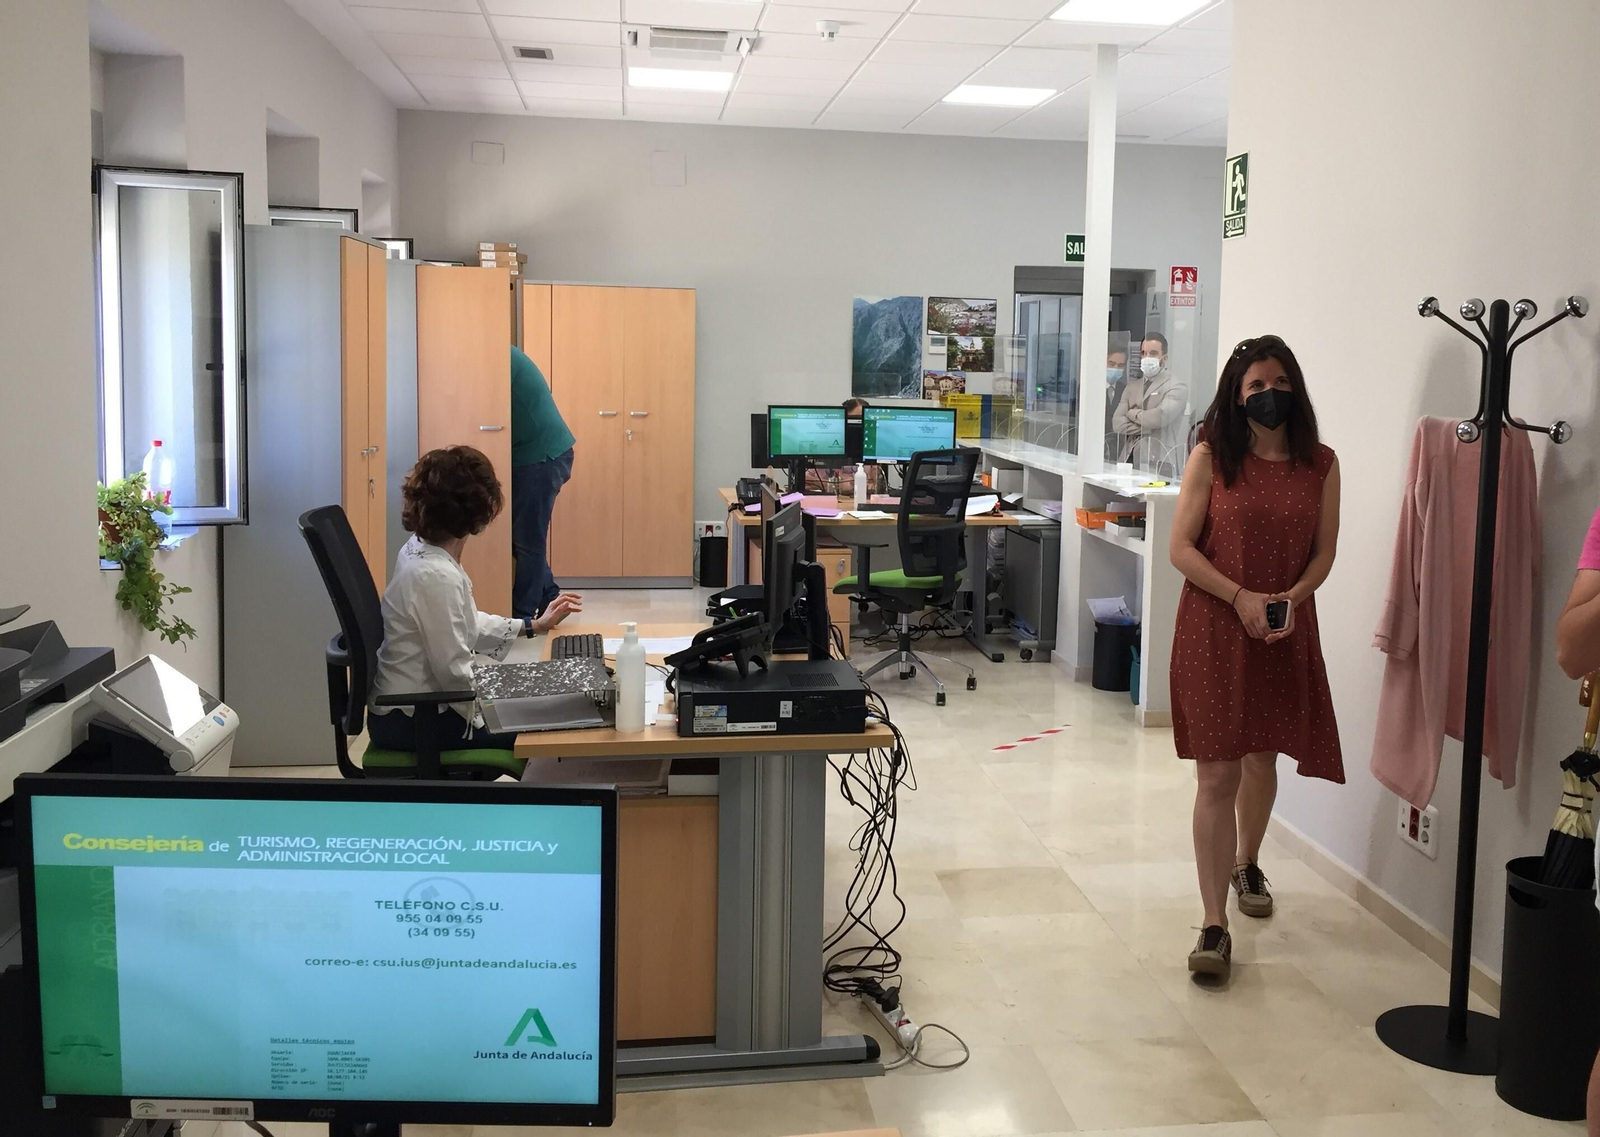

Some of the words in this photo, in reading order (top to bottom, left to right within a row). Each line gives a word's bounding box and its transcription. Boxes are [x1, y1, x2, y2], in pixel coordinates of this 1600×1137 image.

[1225, 217, 1243, 231] SALIDA
[1170, 296, 1196, 306] EXTINTOR
[62, 833, 204, 853] Consejería
[208, 840, 230, 852] de
[237, 836, 320, 850] TURISMO,
[326, 836, 467, 852] REGENERACIÓN,
[472, 839, 544, 852] JUSTICIA
[547, 843, 559, 855] y
[237, 849, 389, 864] ADMINISTRACIÓN
[394, 852, 450, 865] LOCAL
[374, 899, 456, 911] TELÉFONO
[460, 901, 504, 912] C.S.U.
[396, 913, 421, 923] 955
[425, 914, 442, 924] 04
[446, 914, 462, 924] 09
[467, 914, 483, 924] 55
[408, 927, 429, 938] (34
[433, 927, 450, 937] 09
[454, 928, 476, 939] 55)
[304, 957, 369, 967] correo-e:
[372, 957, 577, 970] csu.ius@juntadeandalucia.es
[473, 1050, 509, 1061] Junta
[512, 1050, 528, 1061] de
[530, 1050, 593, 1062] Andalucía
